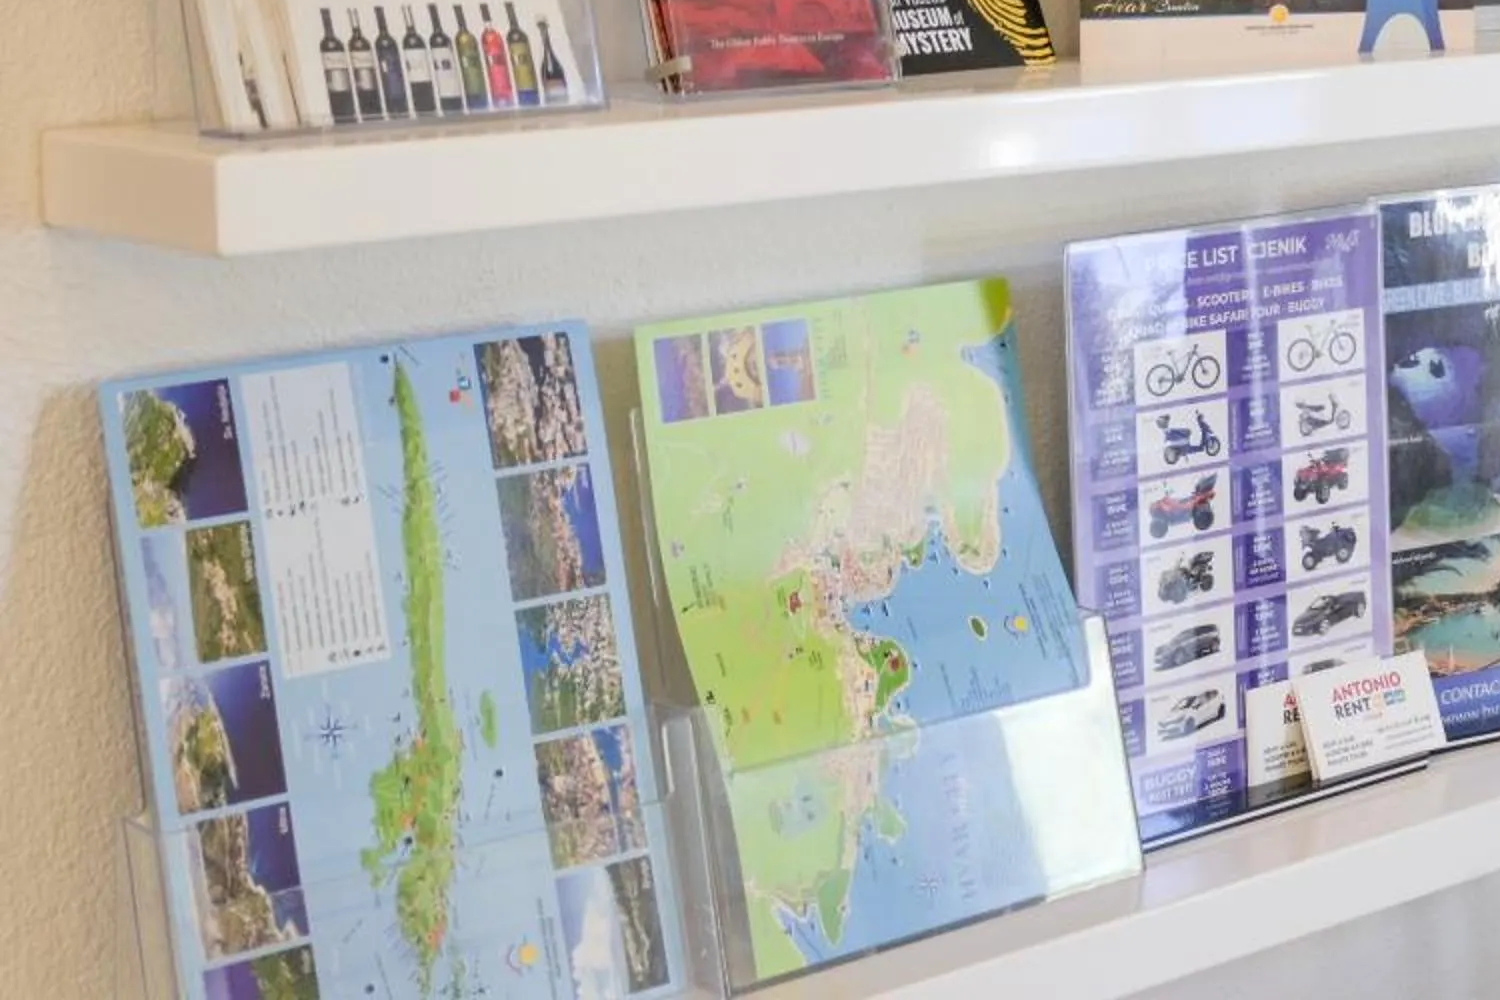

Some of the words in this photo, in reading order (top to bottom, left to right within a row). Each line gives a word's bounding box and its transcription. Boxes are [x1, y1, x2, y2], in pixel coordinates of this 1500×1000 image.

[1202, 245, 1240, 267] LIST
[1331, 671, 1402, 703] ANTONIO
[1334, 697, 1371, 721] RENT
